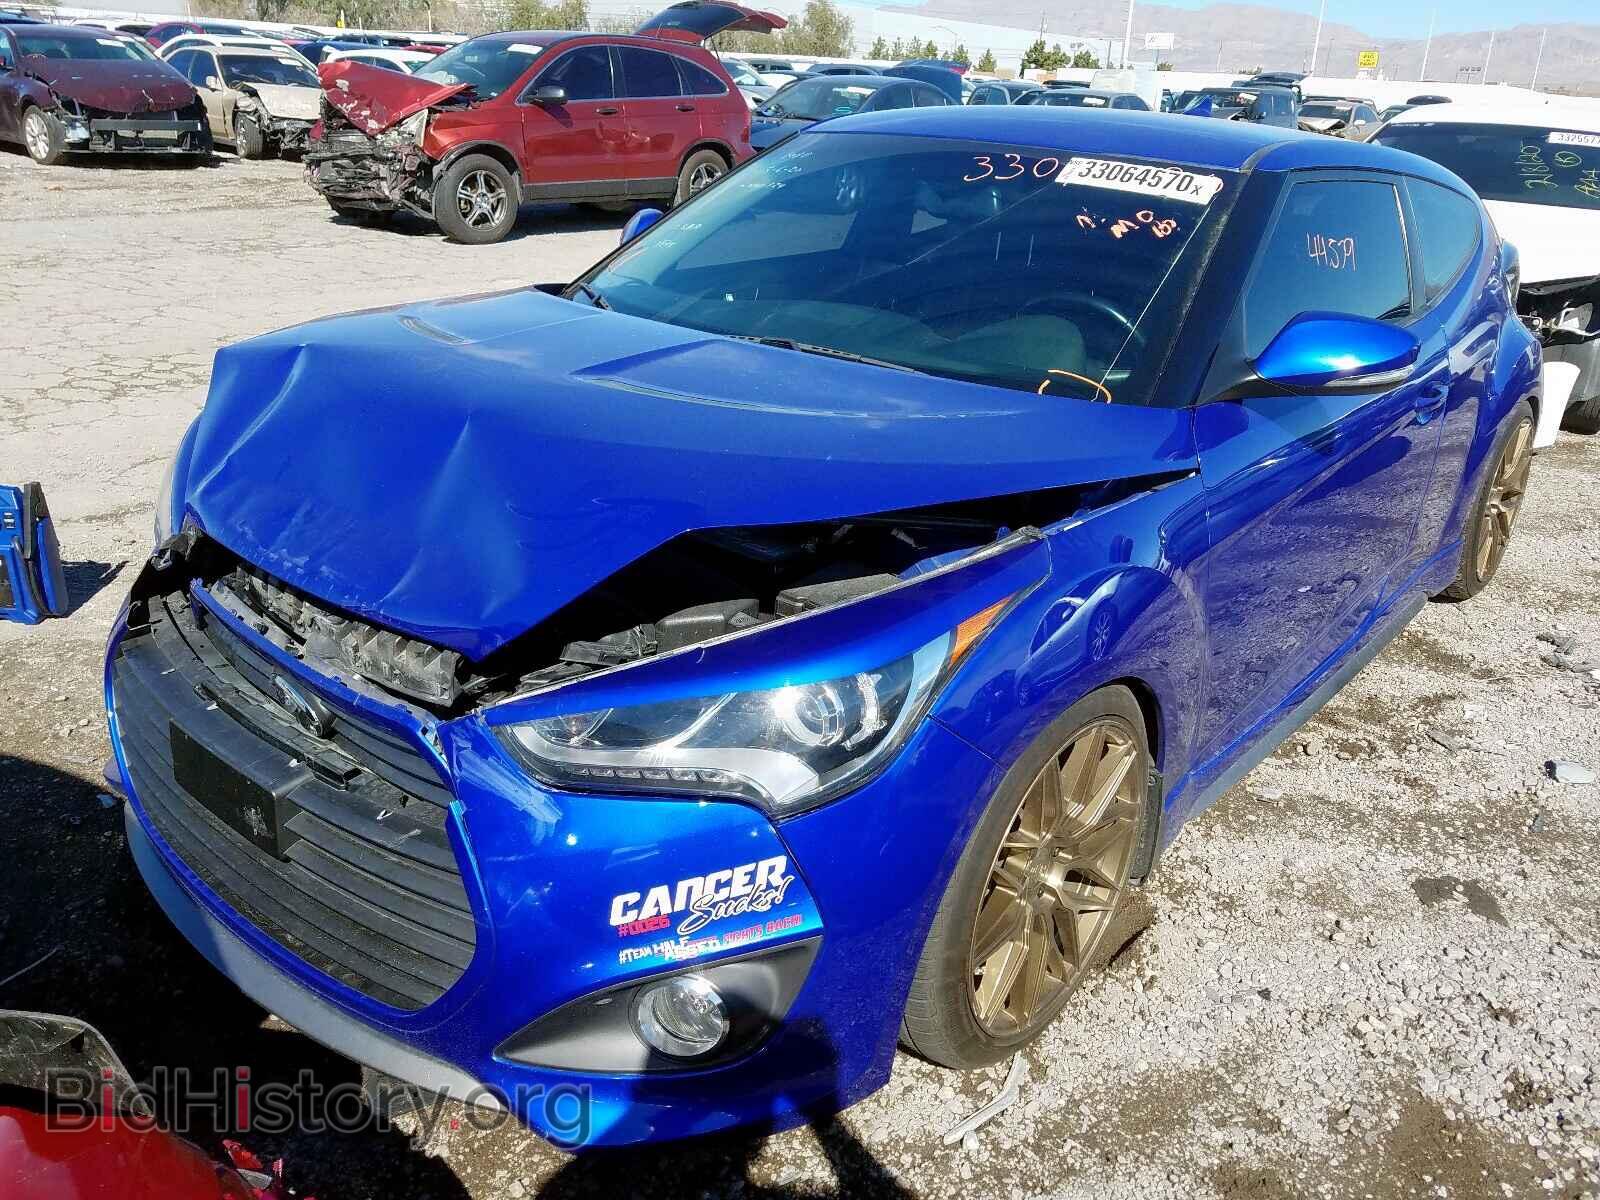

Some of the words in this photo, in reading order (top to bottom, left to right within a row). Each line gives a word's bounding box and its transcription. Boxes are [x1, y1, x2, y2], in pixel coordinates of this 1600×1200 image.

[964, 153, 1059, 182] 330
[609, 855, 788, 926] CANCER
[676, 875, 795, 936] Sucks!
